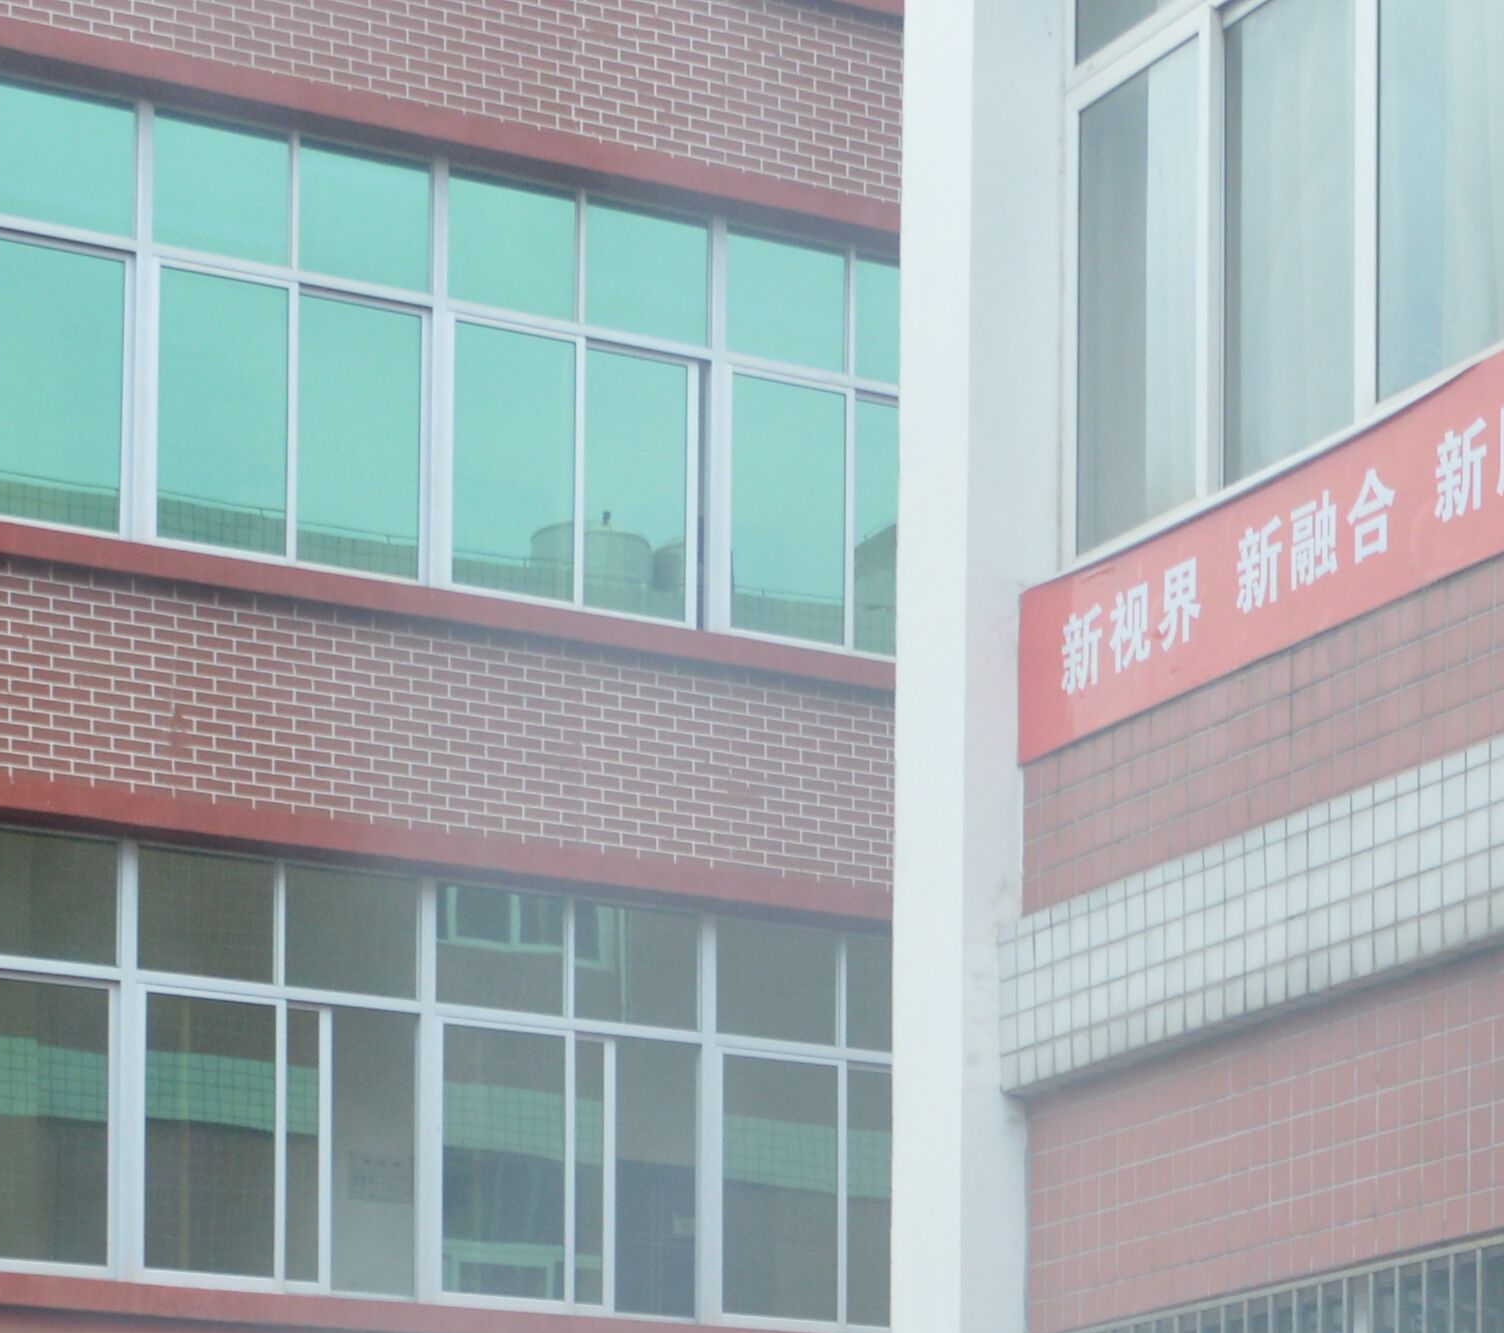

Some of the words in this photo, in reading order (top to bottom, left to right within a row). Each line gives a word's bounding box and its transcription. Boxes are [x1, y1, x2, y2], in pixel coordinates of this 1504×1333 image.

[1060, 557, 1202, 697] 新视界
[1235, 467, 1397, 614] 新融合
